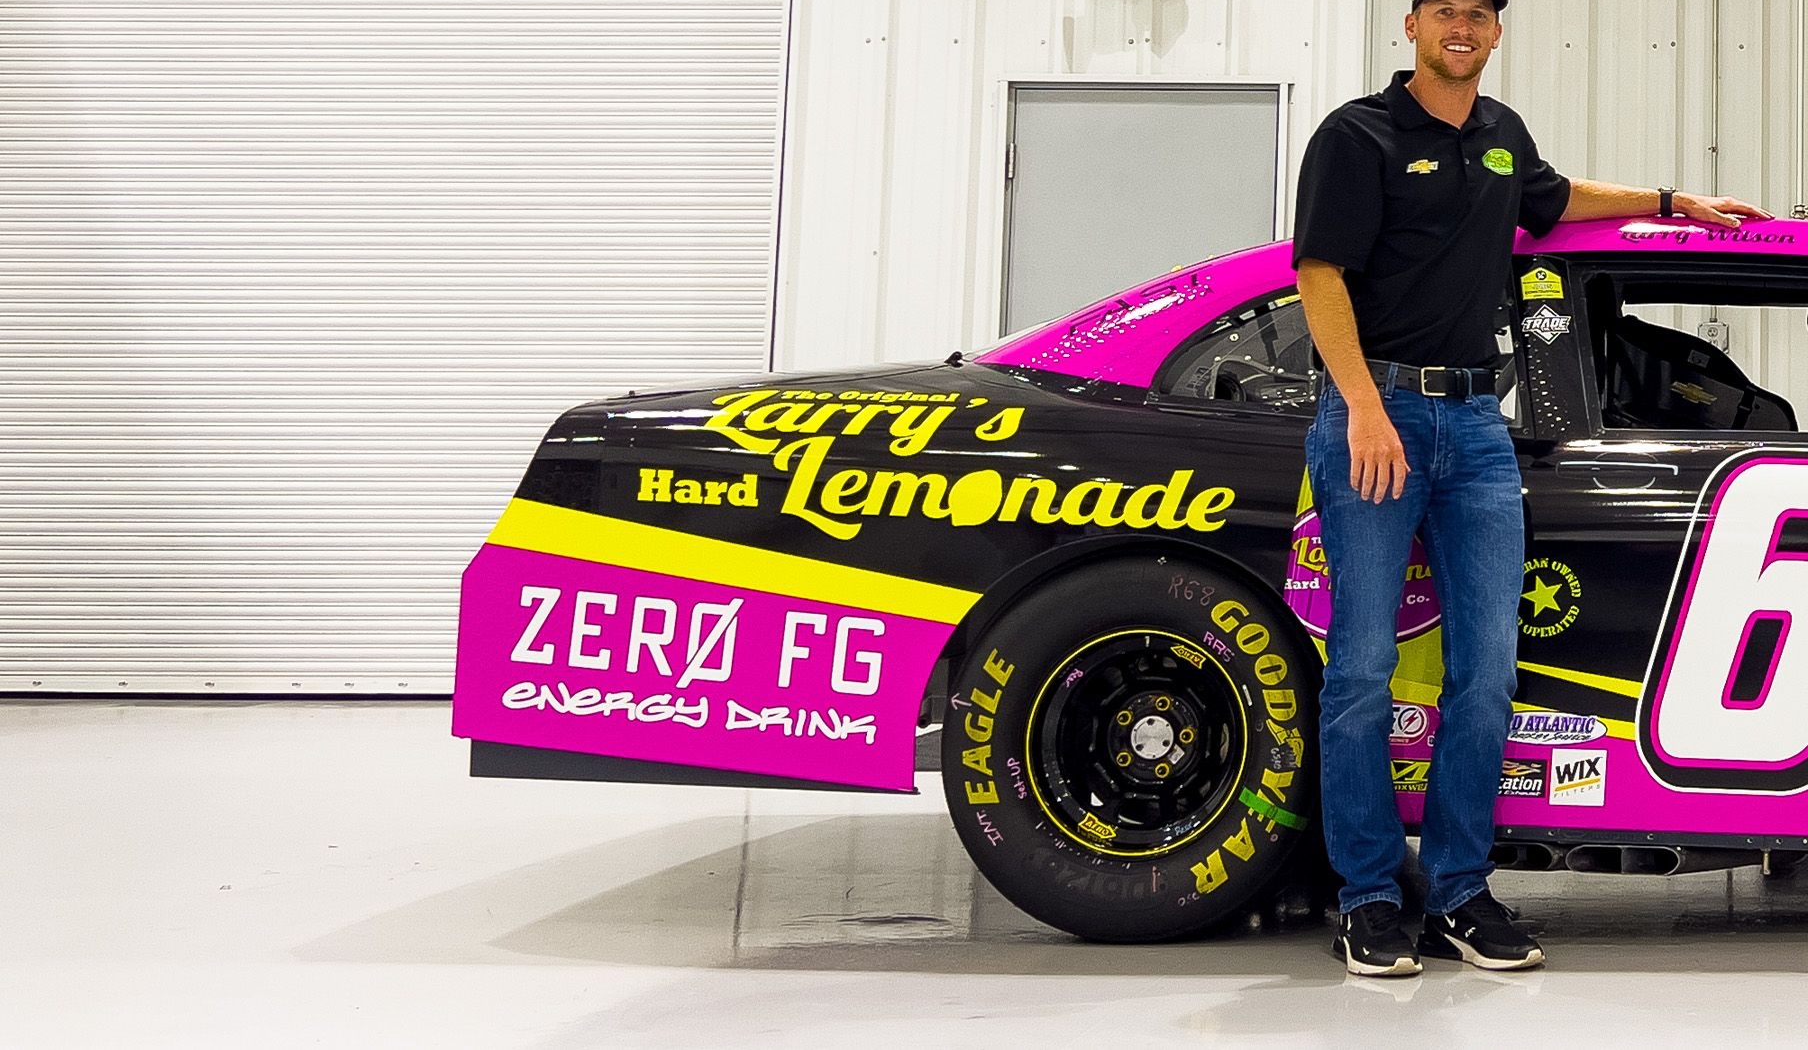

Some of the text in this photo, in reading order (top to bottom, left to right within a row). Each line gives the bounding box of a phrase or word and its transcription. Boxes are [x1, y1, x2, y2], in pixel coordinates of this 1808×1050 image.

[1706, 227, 1796, 244] Wilson
[1524, 316, 1568, 331] TRADE
[781, 389, 958, 404] The Original
[702, 388, 1026, 456] Larry's
[636, 434, 1237, 541] Hard Lemonade
[1551, 561, 1582, 598] OWNED
[1406, 594, 1430, 605] Co.
[1522, 605, 1580, 638] OPERATED
[777, 610, 886, 696] FG
[725, 700, 877, 745] DRINK
[962, 649, 1016, 805] EAGLE
[1523, 714, 1597, 734] ATLANTIC
[1555, 756, 1601, 785] WIX
